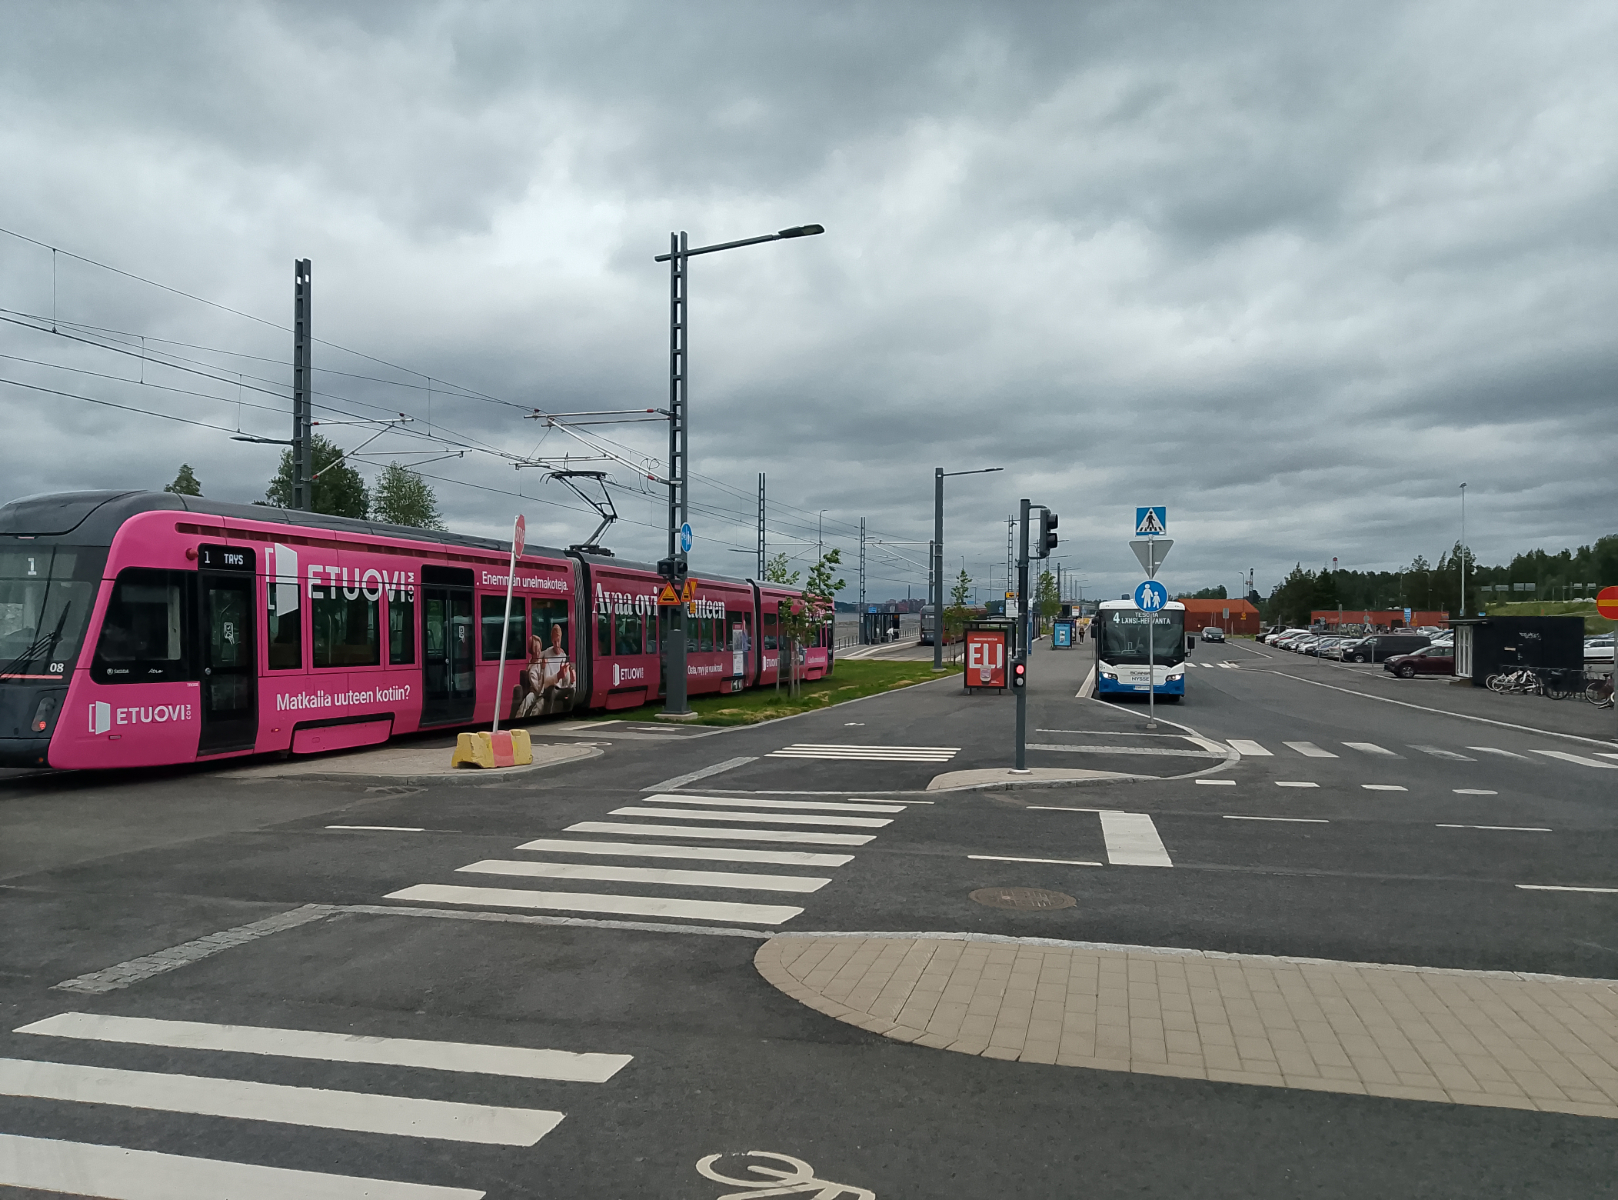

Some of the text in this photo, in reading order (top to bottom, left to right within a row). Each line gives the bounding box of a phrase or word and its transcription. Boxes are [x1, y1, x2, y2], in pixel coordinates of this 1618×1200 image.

[28, 558, 37, 575] 1
[204, 551, 244, 565] 1 TAYS
[307, 564, 406, 603] ETUOVI
[522, 575, 569, 594] unelmakoteja.
[592, 582, 634, 616] Avaa
[635, 586, 659, 617] ovi
[1113, 611, 1121, 624] 4
[969, 643, 1003, 669] ELI
[49, 663, 65, 673] 08
[620, 667, 642, 681] ETUOVI
[276, 685, 411, 712] Matkalla uuteen kotiin?
[116, 704, 185, 725] ETUOVI
